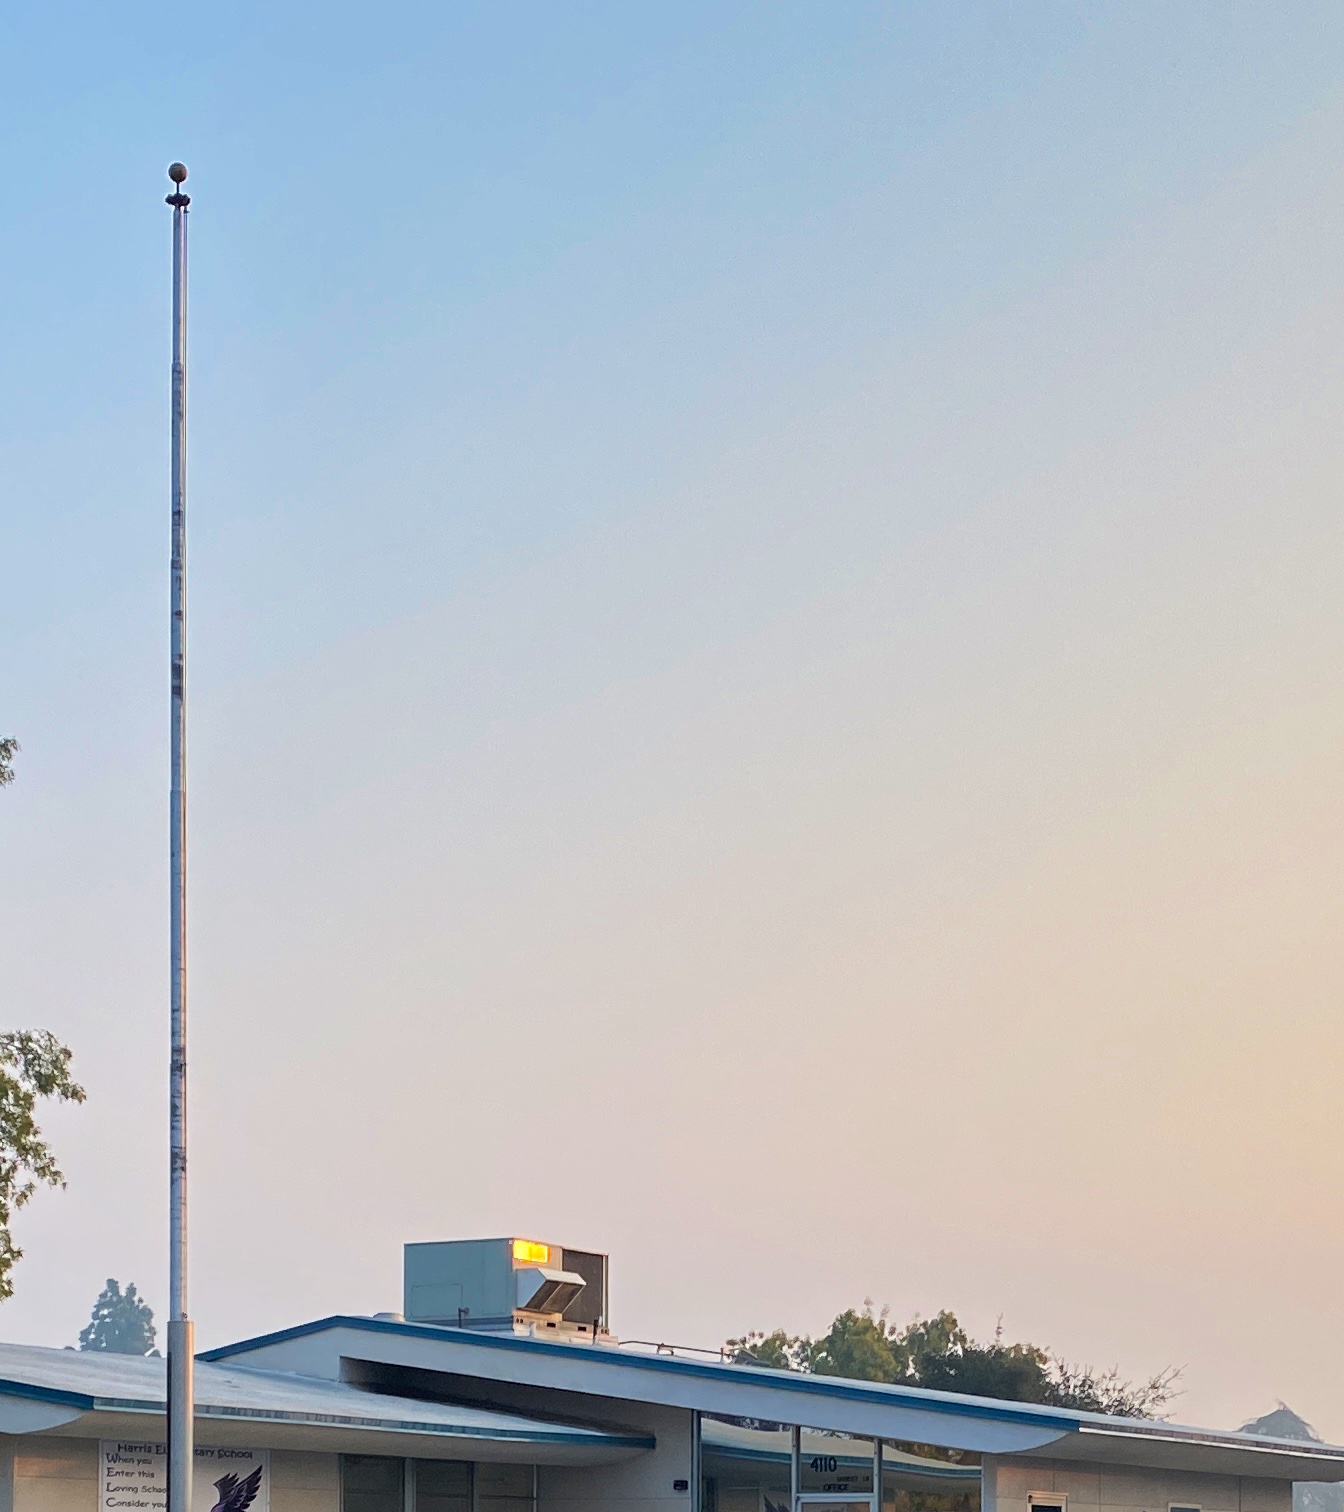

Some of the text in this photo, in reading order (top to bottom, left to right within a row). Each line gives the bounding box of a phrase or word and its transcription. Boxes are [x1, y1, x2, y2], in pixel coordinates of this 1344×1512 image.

[117, 1443, 152, 1453] Harris
[218, 1450, 253, 1459] School
[106, 1453, 135, 1464] When
[810, 1456, 837, 1472] 4110
[106, 1467, 155, 1478] Enter this
[106, 1482, 167, 1494] Loving Schoo
[106, 1497, 149, 1508] Consider
